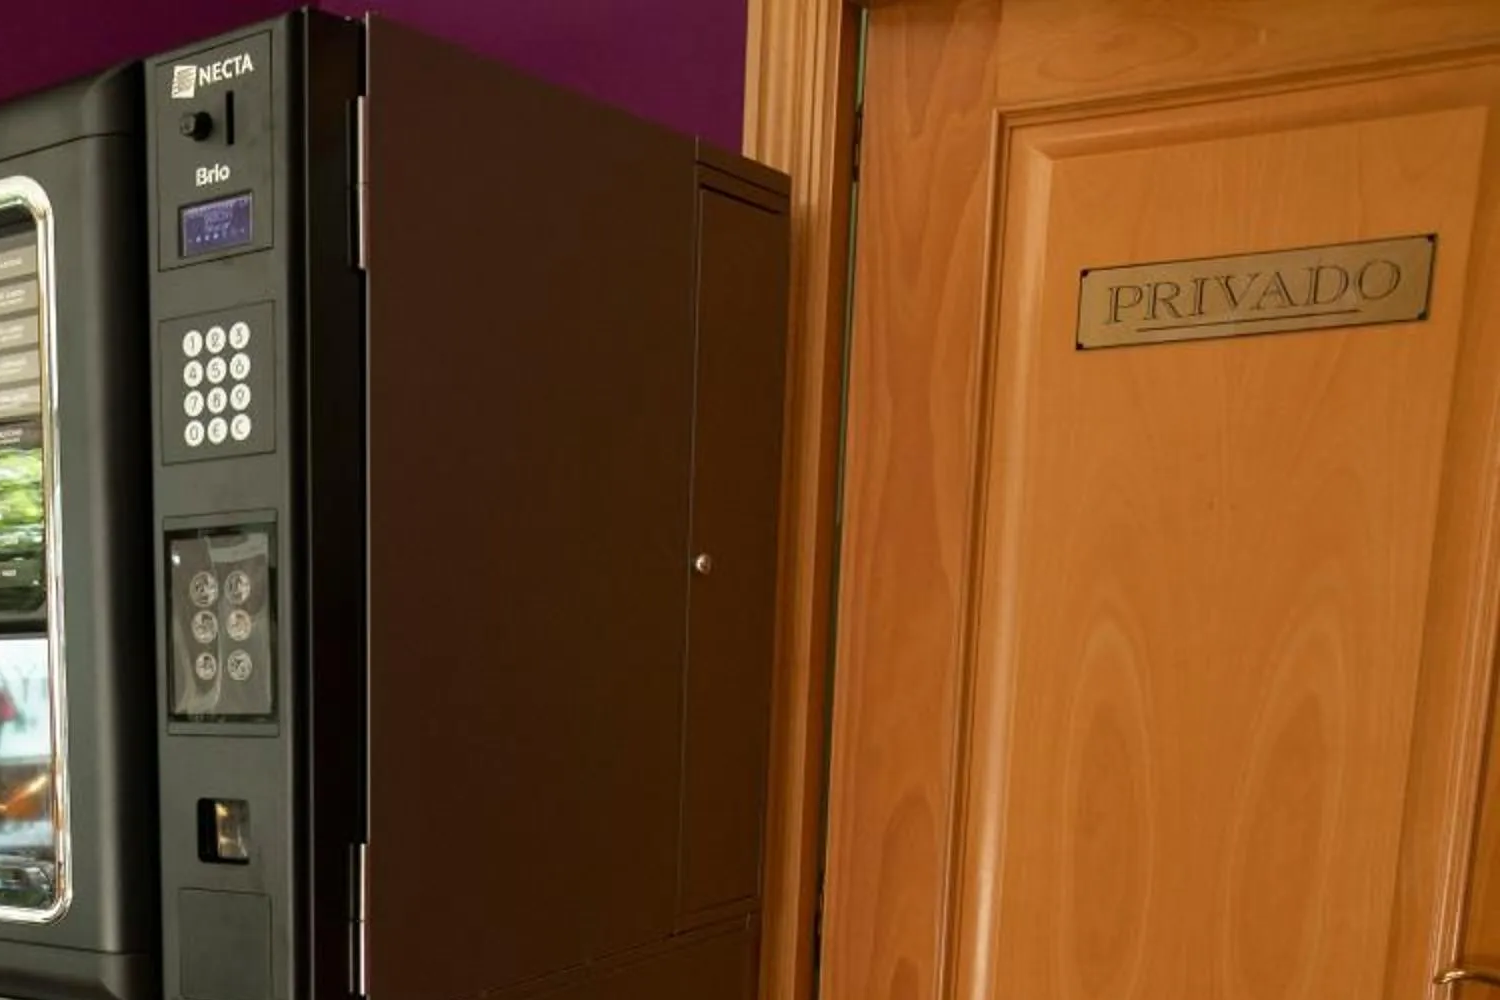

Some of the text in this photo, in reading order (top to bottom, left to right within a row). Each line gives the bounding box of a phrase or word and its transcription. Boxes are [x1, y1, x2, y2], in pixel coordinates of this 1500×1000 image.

[199, 53, 254, 87] NECTA
[195, 163, 231, 186] Brio
[1104, 258, 1401, 325] PRIVADO
